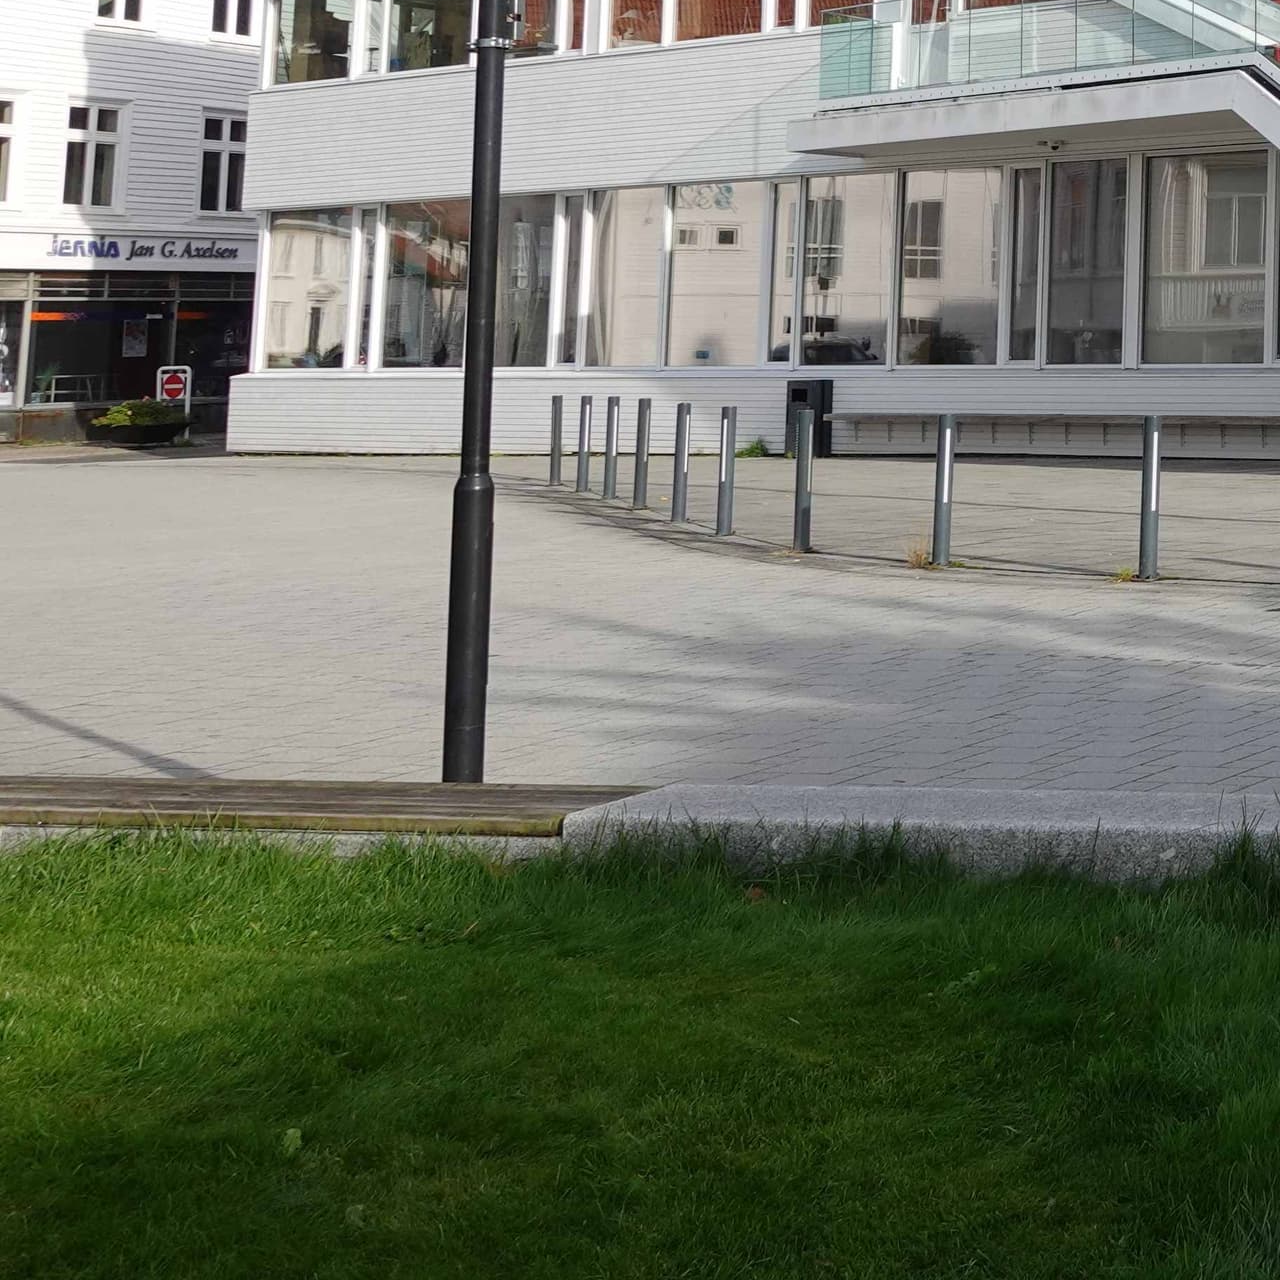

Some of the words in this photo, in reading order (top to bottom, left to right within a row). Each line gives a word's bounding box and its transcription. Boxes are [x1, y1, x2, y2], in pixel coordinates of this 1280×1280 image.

[125, 239, 155, 261] Jan
[161, 239, 178, 259] G.
[180, 240, 239, 259] Axelsen
